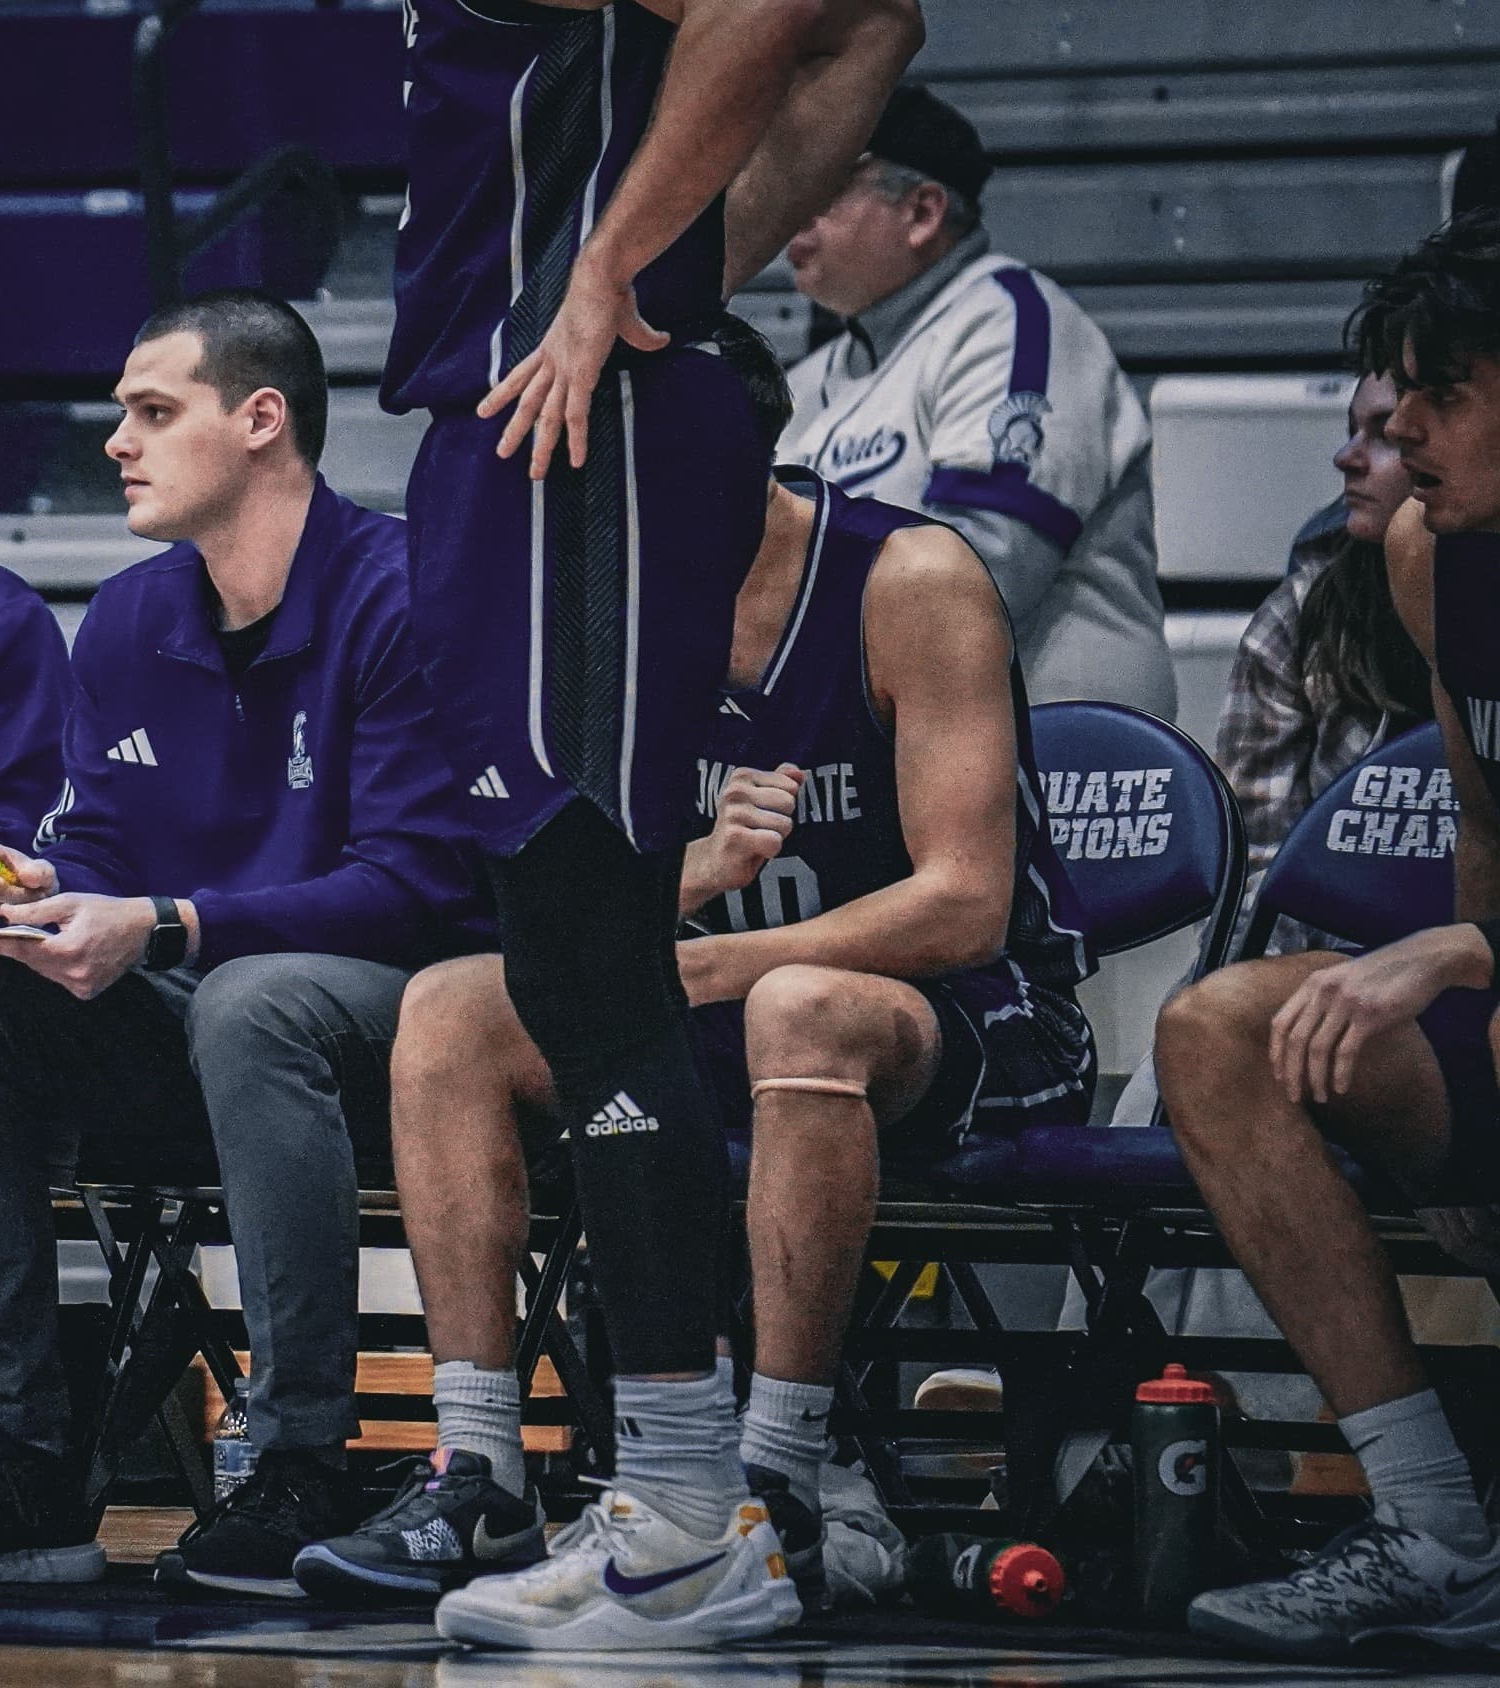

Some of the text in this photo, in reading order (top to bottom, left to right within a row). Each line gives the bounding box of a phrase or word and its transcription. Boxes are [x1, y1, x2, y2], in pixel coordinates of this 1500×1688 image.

[797, 763, 862, 824] ATE
[1047, 769, 1173, 814] UATE
[1351, 765, 1460, 811] GRA
[1049, 813, 1173, 860] PIONS
[585, 1117, 659, 1137] adidas
[1158, 1440, 1207, 1496] G
